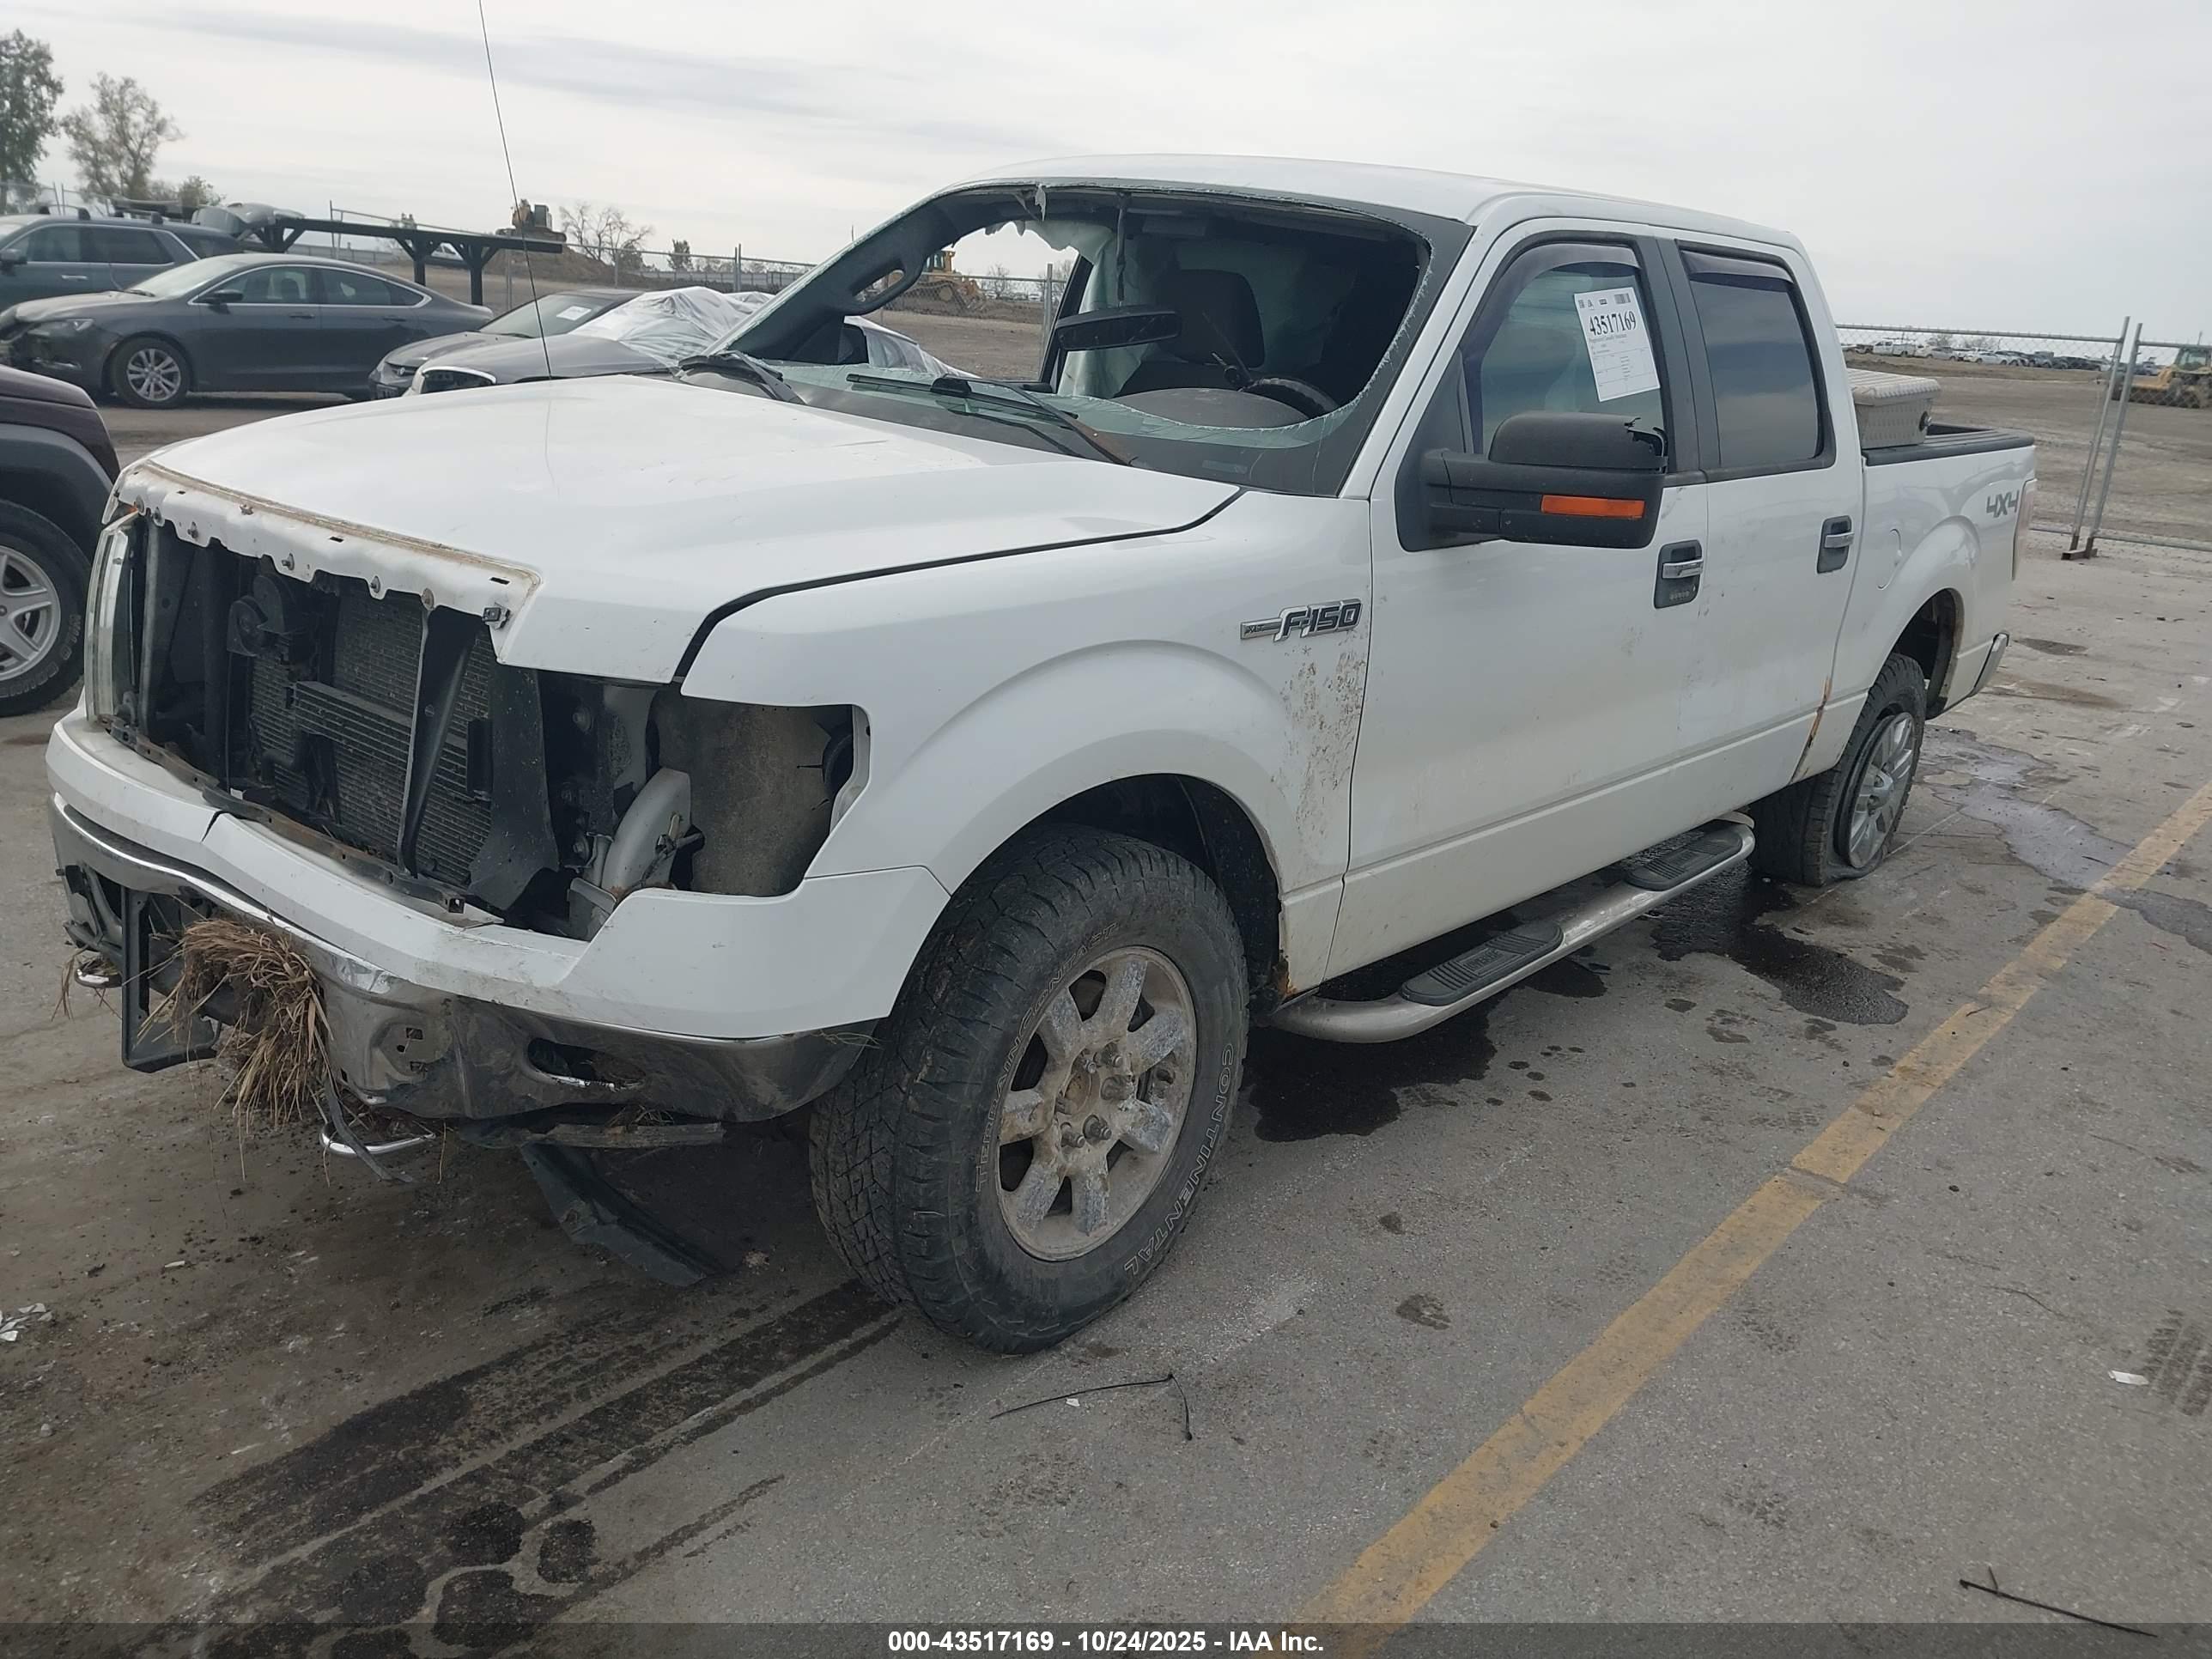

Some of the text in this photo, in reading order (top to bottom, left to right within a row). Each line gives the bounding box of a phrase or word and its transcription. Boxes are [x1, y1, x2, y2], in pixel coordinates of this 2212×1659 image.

[1589, 310, 1637, 336] 43517169
[1986, 489, 2020, 518] 4X4
[1124, 1043, 1234, 1275] CONTINENTAL
